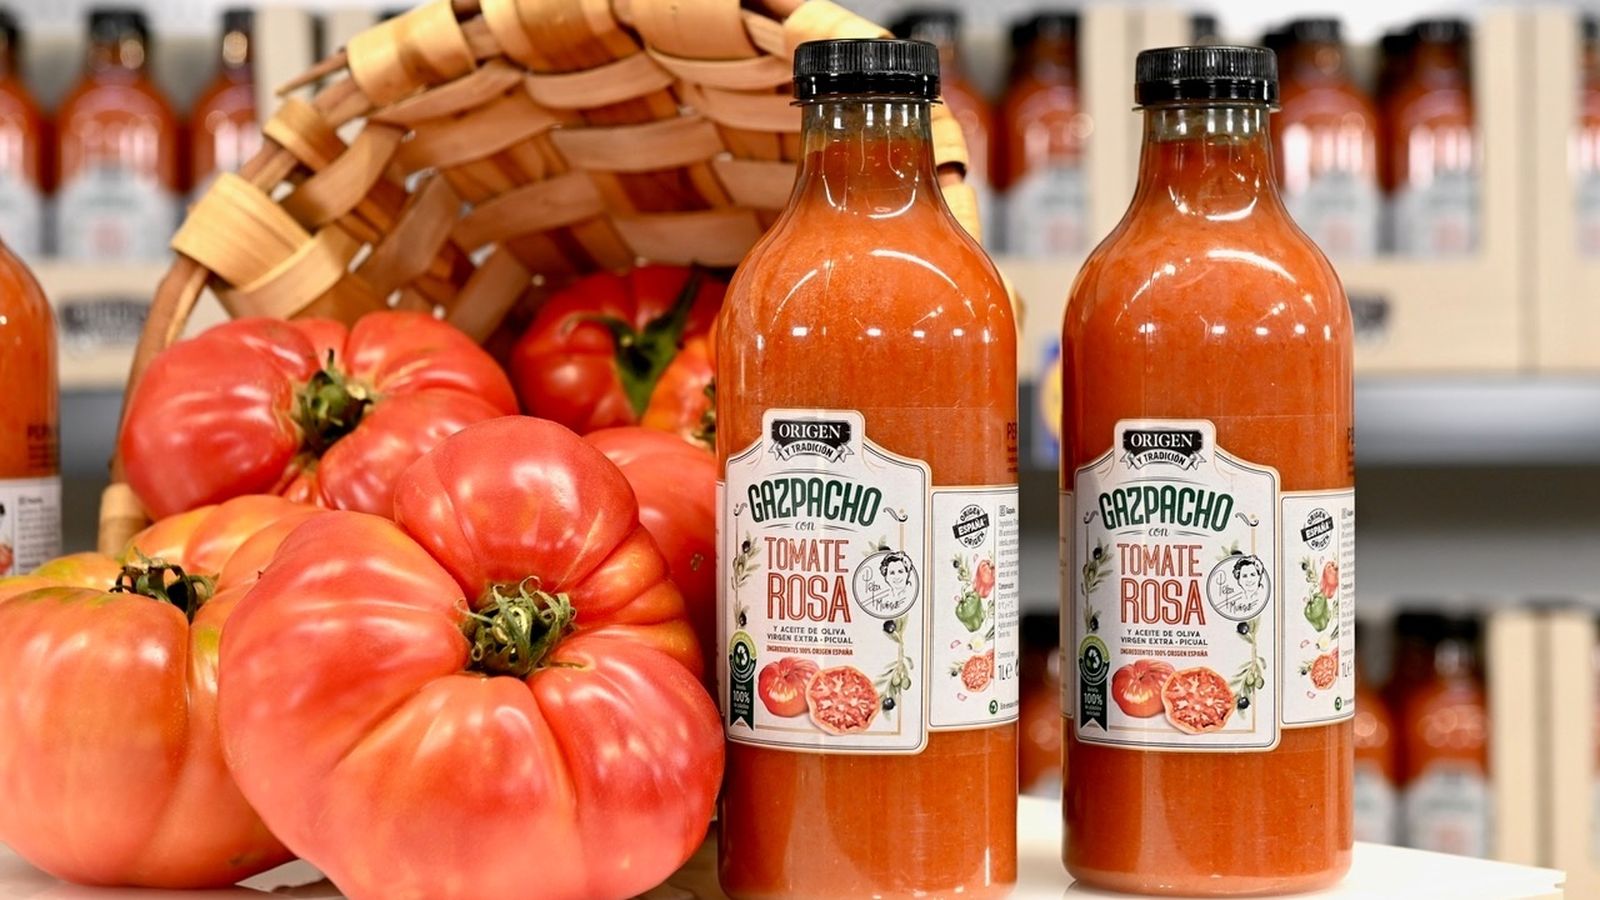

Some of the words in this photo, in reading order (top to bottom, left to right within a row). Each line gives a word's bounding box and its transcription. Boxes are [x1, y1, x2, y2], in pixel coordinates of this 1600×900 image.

[779, 423, 841, 439] ORIGEN
[1130, 433, 1193, 448] ORIGEN
[784, 446, 791, 456] Y
[791, 442, 834, 458] TRADICIÓN
[1136, 457, 1143, 465] Y
[1144, 451, 1187, 466] TRADICIÓN
[747, 477, 882, 527] GAZPACHO
[1099, 484, 1234, 532] GAZPACHO
[960, 507, 980, 521] ORIGEN
[1307, 510, 1326, 525] ORIGEN
[795, 521, 816, 532] con
[1148, 526, 1169, 537] con
[764, 537, 849, 574] TOMATE
[1117, 543, 1203, 578] TOMATE
[766, 573, 852, 624] ROSA
[1120, 579, 1206, 626] ROSA
[780, 626, 805, 634] ACEITE
[808, 627, 818, 635] DE
[821, 628, 846, 636] OLIVA
[1135, 629, 1160, 637] ACEITE
[767, 633, 792, 641] VIRGEN
[794, 635, 819, 643] EXTRA
[824, 637, 853, 645] PICUAL
[1120, 637, 1146, 645] VIRGEN
[812, 648, 832, 656] ORIGEN
[832, 648, 854, 656] ESPAÑA
[733, 690, 751, 704] 100%
[1084, 692, 1103, 706] 100%
